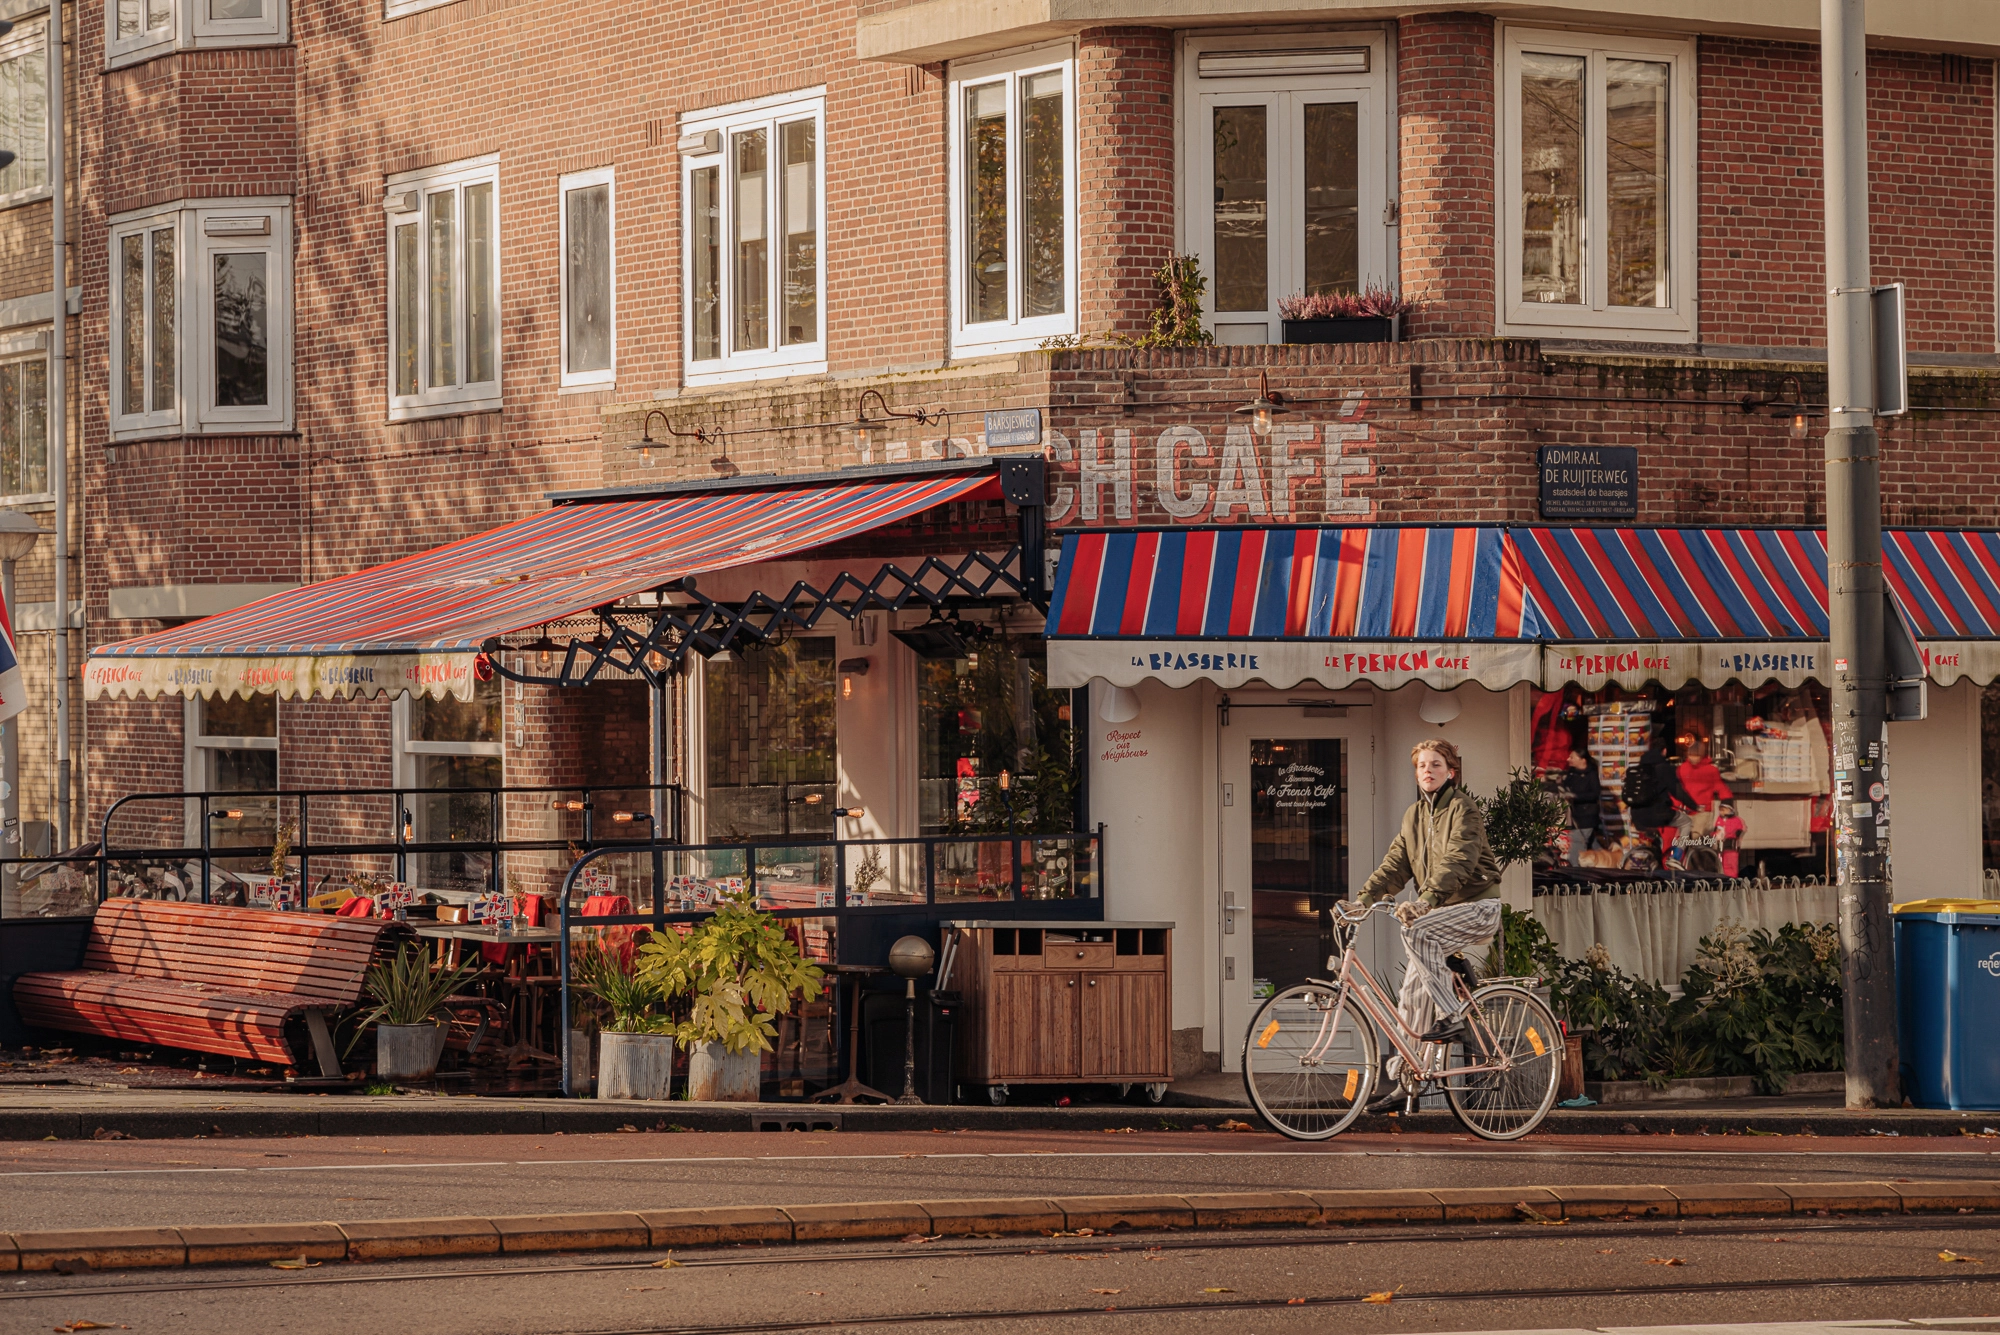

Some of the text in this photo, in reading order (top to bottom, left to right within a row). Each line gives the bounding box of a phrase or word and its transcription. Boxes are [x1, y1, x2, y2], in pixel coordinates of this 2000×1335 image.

[987, 414, 1036, 432] BAARSJESWEG
[1157, 391, 1374, 521] CAFÉ
[1545, 450, 1601, 465] ADMIRAAL
[1545, 469, 1628, 487] DE RUIJTERWEG
[1552, 488, 1628, 499] stadsdeel de baarsjes
[1131, 651, 1260, 671] LA BRASSERIE
[1324, 650, 1470, 674] LE FRENCH CAFÉ
[1560, 650, 1670, 675] LE FRENCH CAFÉ
[1720, 653, 1815, 672] LA BRASSERIE
[1934, 653, 1959, 667] CAFÉ
[96, 664, 129, 685] FRENCH
[174, 667, 212, 685] BRASSERIE
[246, 663, 280, 687] FRENCH
[328, 666, 374, 685] BRASSERIE
[406, 668, 413, 680] LE
[414, 660, 452, 686] FRENCH
[1106, 730, 1142, 742] Respect
[1116, 742, 1130, 750] our
[1100, 748, 1149, 763] Neighbours
[1278, 762, 1325, 776] la Brasserie
[1266, 783, 1336, 799] le French Café
[1311, 801, 1327, 809] jours
[1680, 835, 1703, 847] French
[1978, 960, 2000, 968] rene
